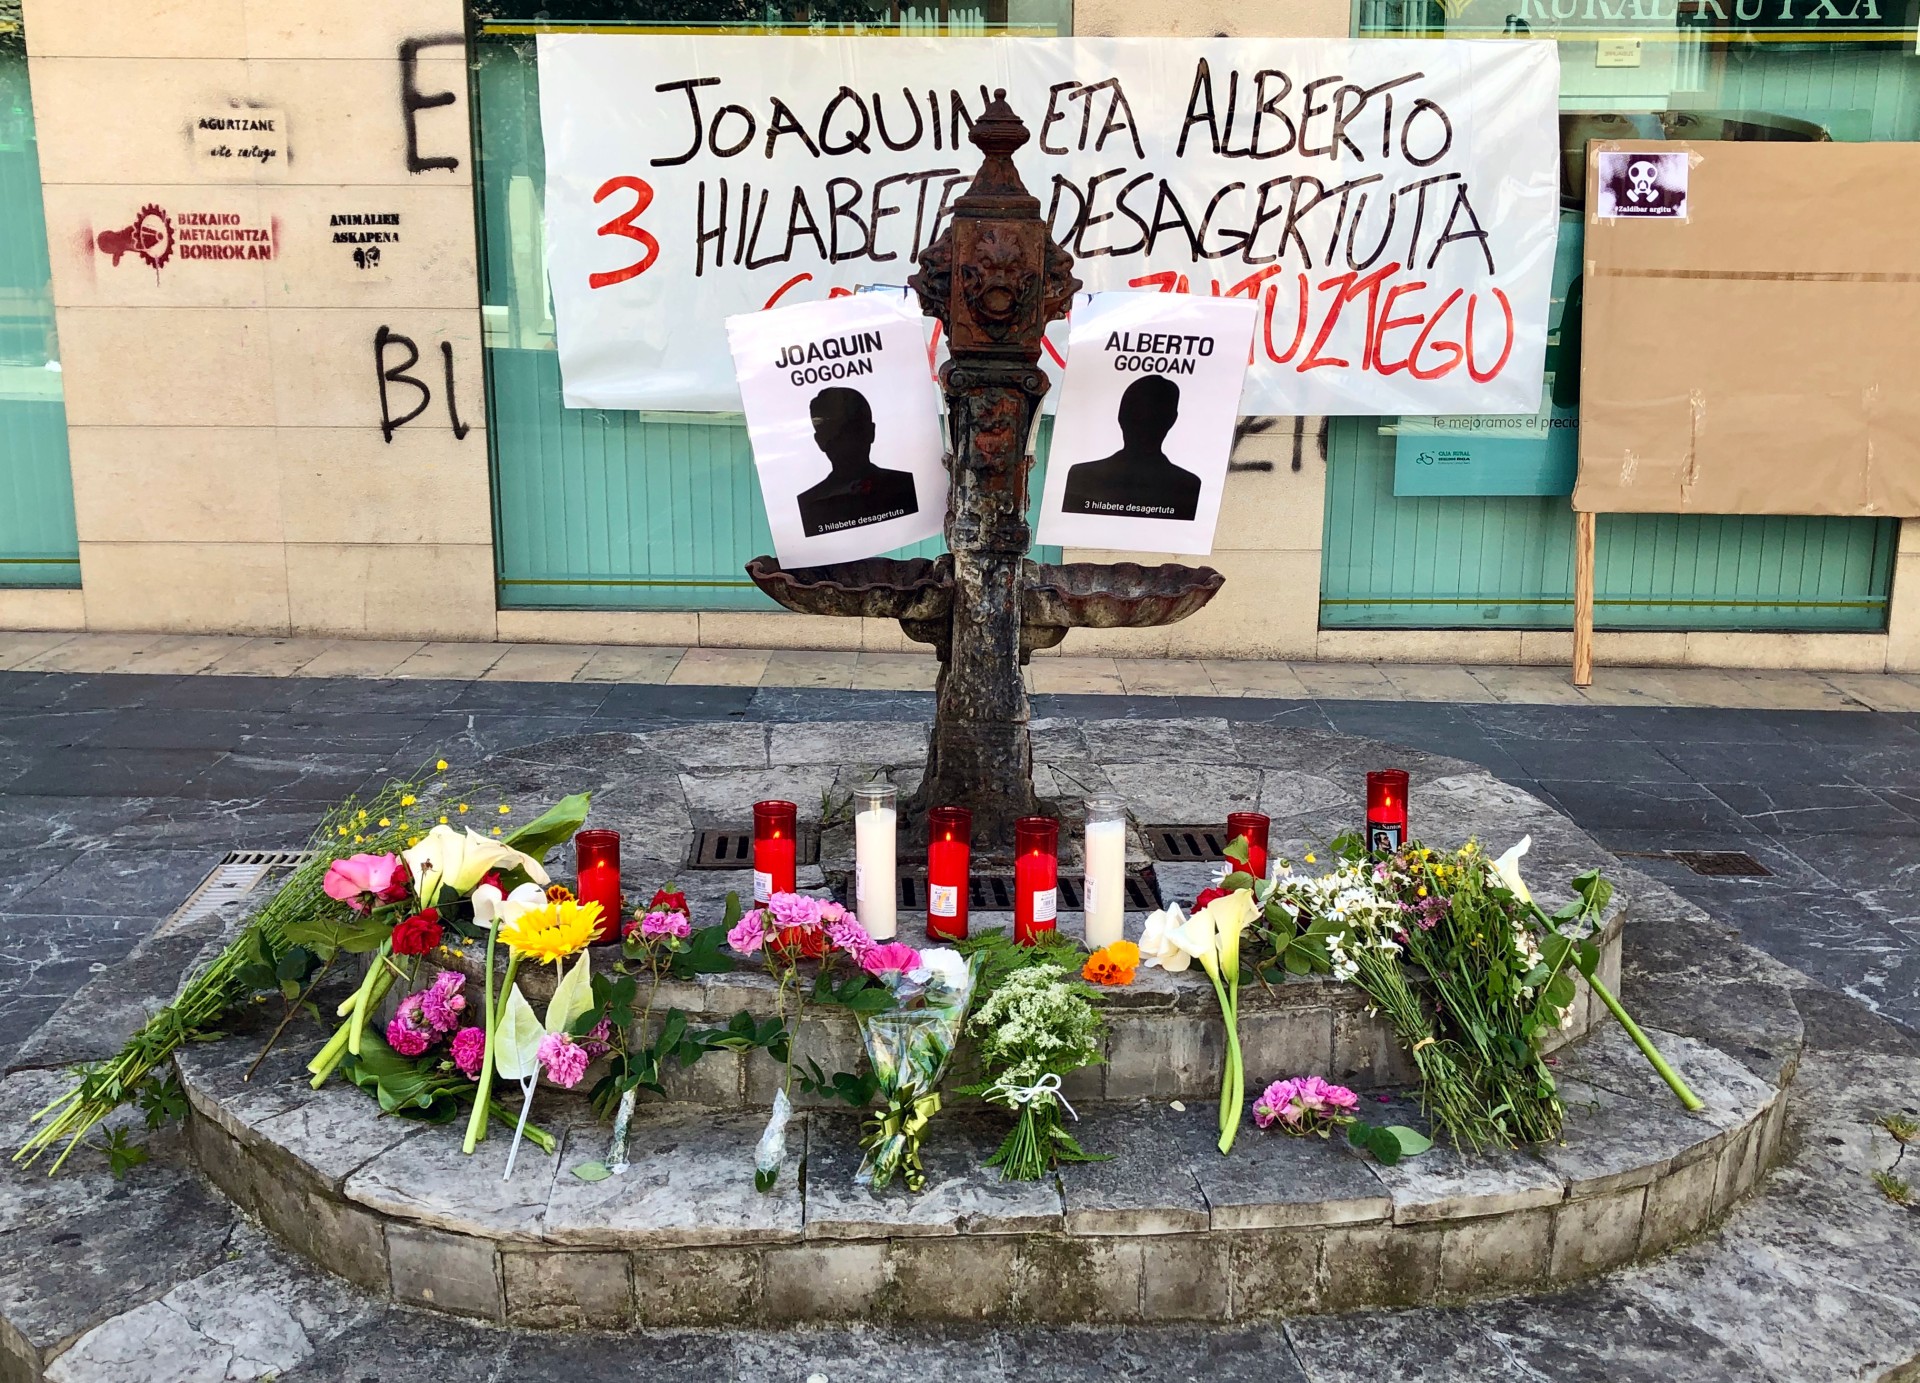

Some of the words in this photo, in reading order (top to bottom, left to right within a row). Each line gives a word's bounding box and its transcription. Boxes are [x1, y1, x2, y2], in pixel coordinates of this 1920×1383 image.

[650, 77, 991, 167] JOAQUIN
[1039, 77, 1145, 160] ETA
[1176, 57, 1453, 168] ALBERTO
[199, 118, 276, 131] AGURTZANE
[1649, 206, 1672, 214] argitu
[178, 213, 241, 225] BIZKAIKO
[329, 213, 400, 226] ANIMALIEN
[180, 229, 270, 241] METALGINTZA
[588, 175, 660, 290] 3
[696, 168, 976, 277] HILABETE
[1045, 166, 1496, 276] DESAGERTUTA
[332, 232, 400, 243] ASKAPENA
[180, 245, 271, 260] BORROKAN
[775, 331, 883, 369] JOAQUIN
[1105, 331, 1215, 357] ALBERTO
[790, 358, 873, 387] GOGOAN
[1114, 355, 1196, 375] GOGOAN
[1432, 417, 1445, 429] Te
[1449, 417, 1522, 431] mejoramos
[1526, 416, 1537, 428] el
[1541, 416, 1579, 431] precio
[1084, 501, 1090, 509] 3
[1091, 501, 1124, 511] hilabete
[1126, 503, 1175, 514] desagertuta
[825, 518, 857, 531] hilabete
[858, 508, 905, 524] desagertuta
